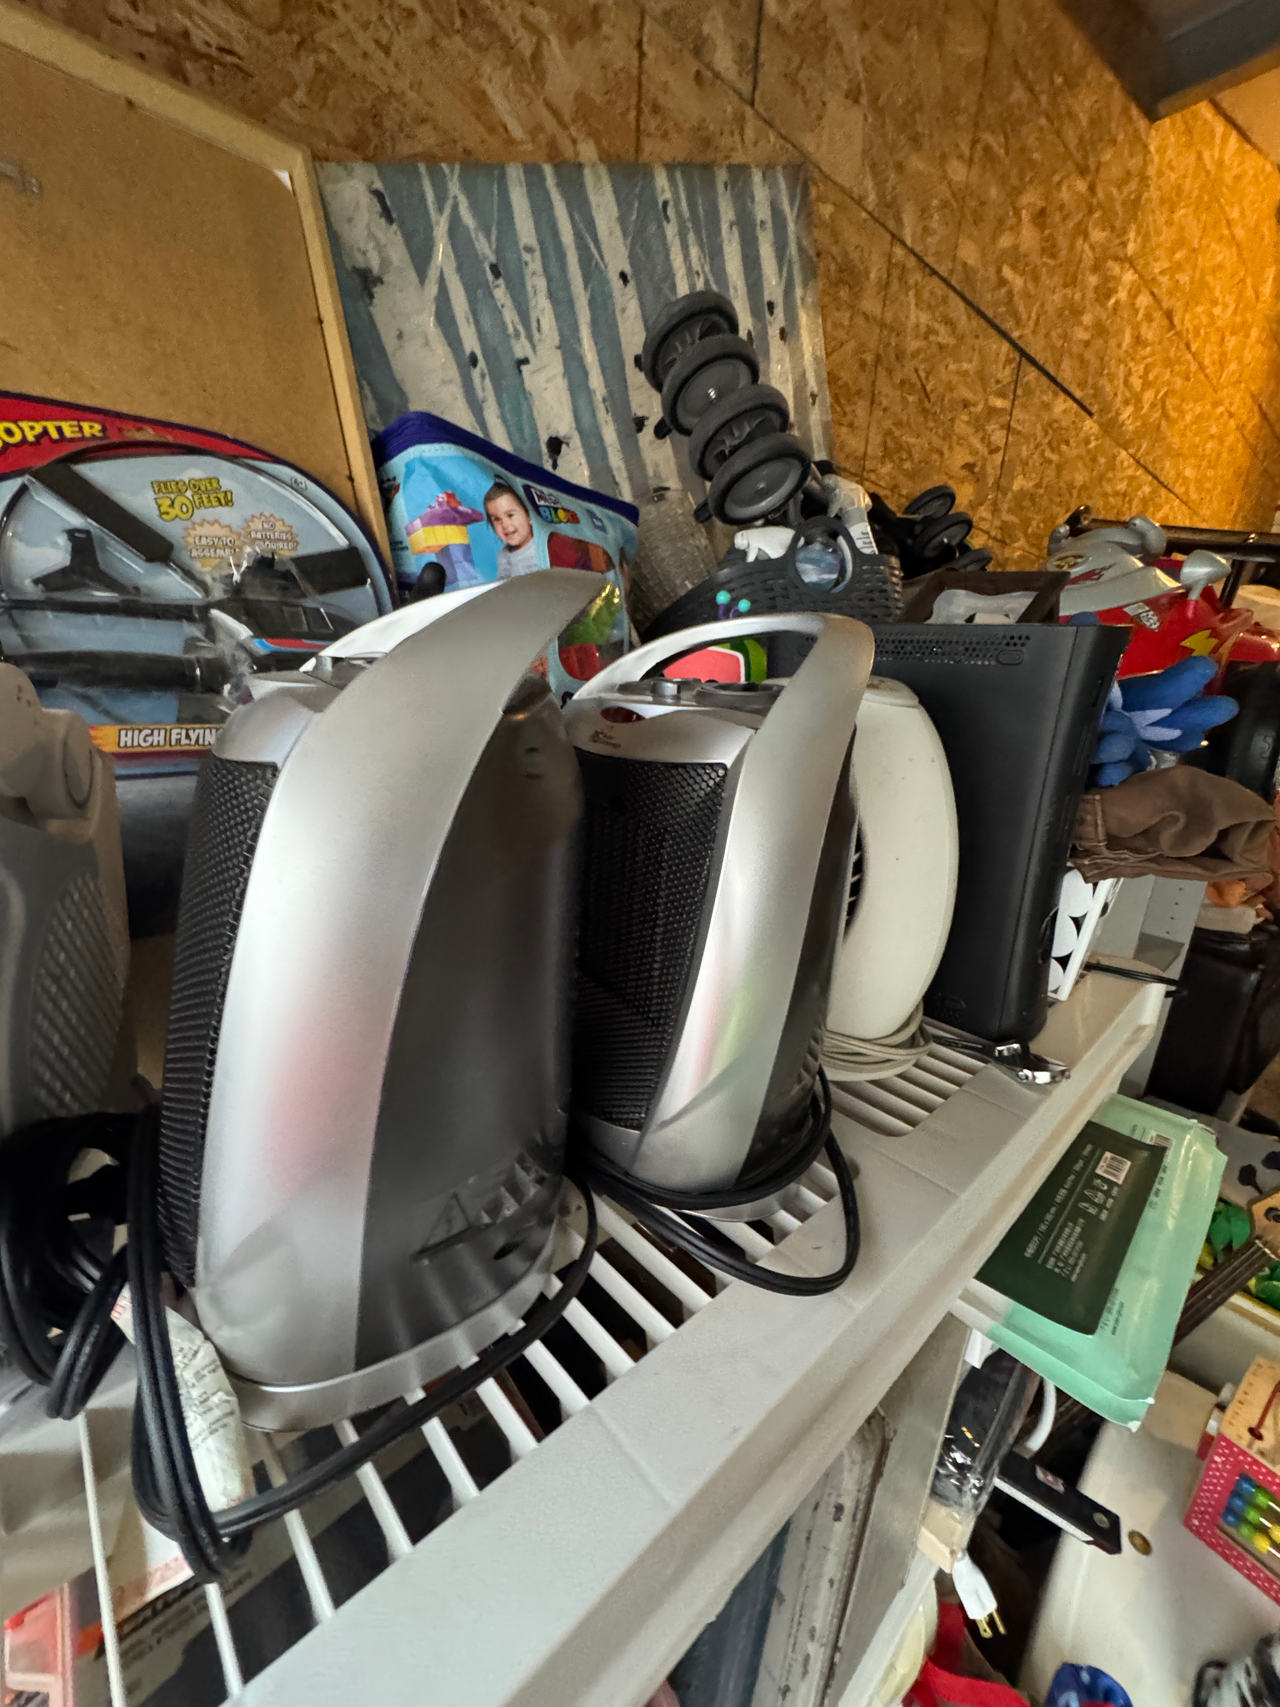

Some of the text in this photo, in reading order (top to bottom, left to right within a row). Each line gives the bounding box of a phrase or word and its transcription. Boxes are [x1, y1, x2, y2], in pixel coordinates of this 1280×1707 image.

[0, 420, 104, 447] OPTER
[151, 477, 221, 495] FLIES OVER
[154, 490, 234, 522] 30 FEET!
[194, 536, 235, 547] EASY TO
[119, 727, 222, 748] HIGH FLYIN
